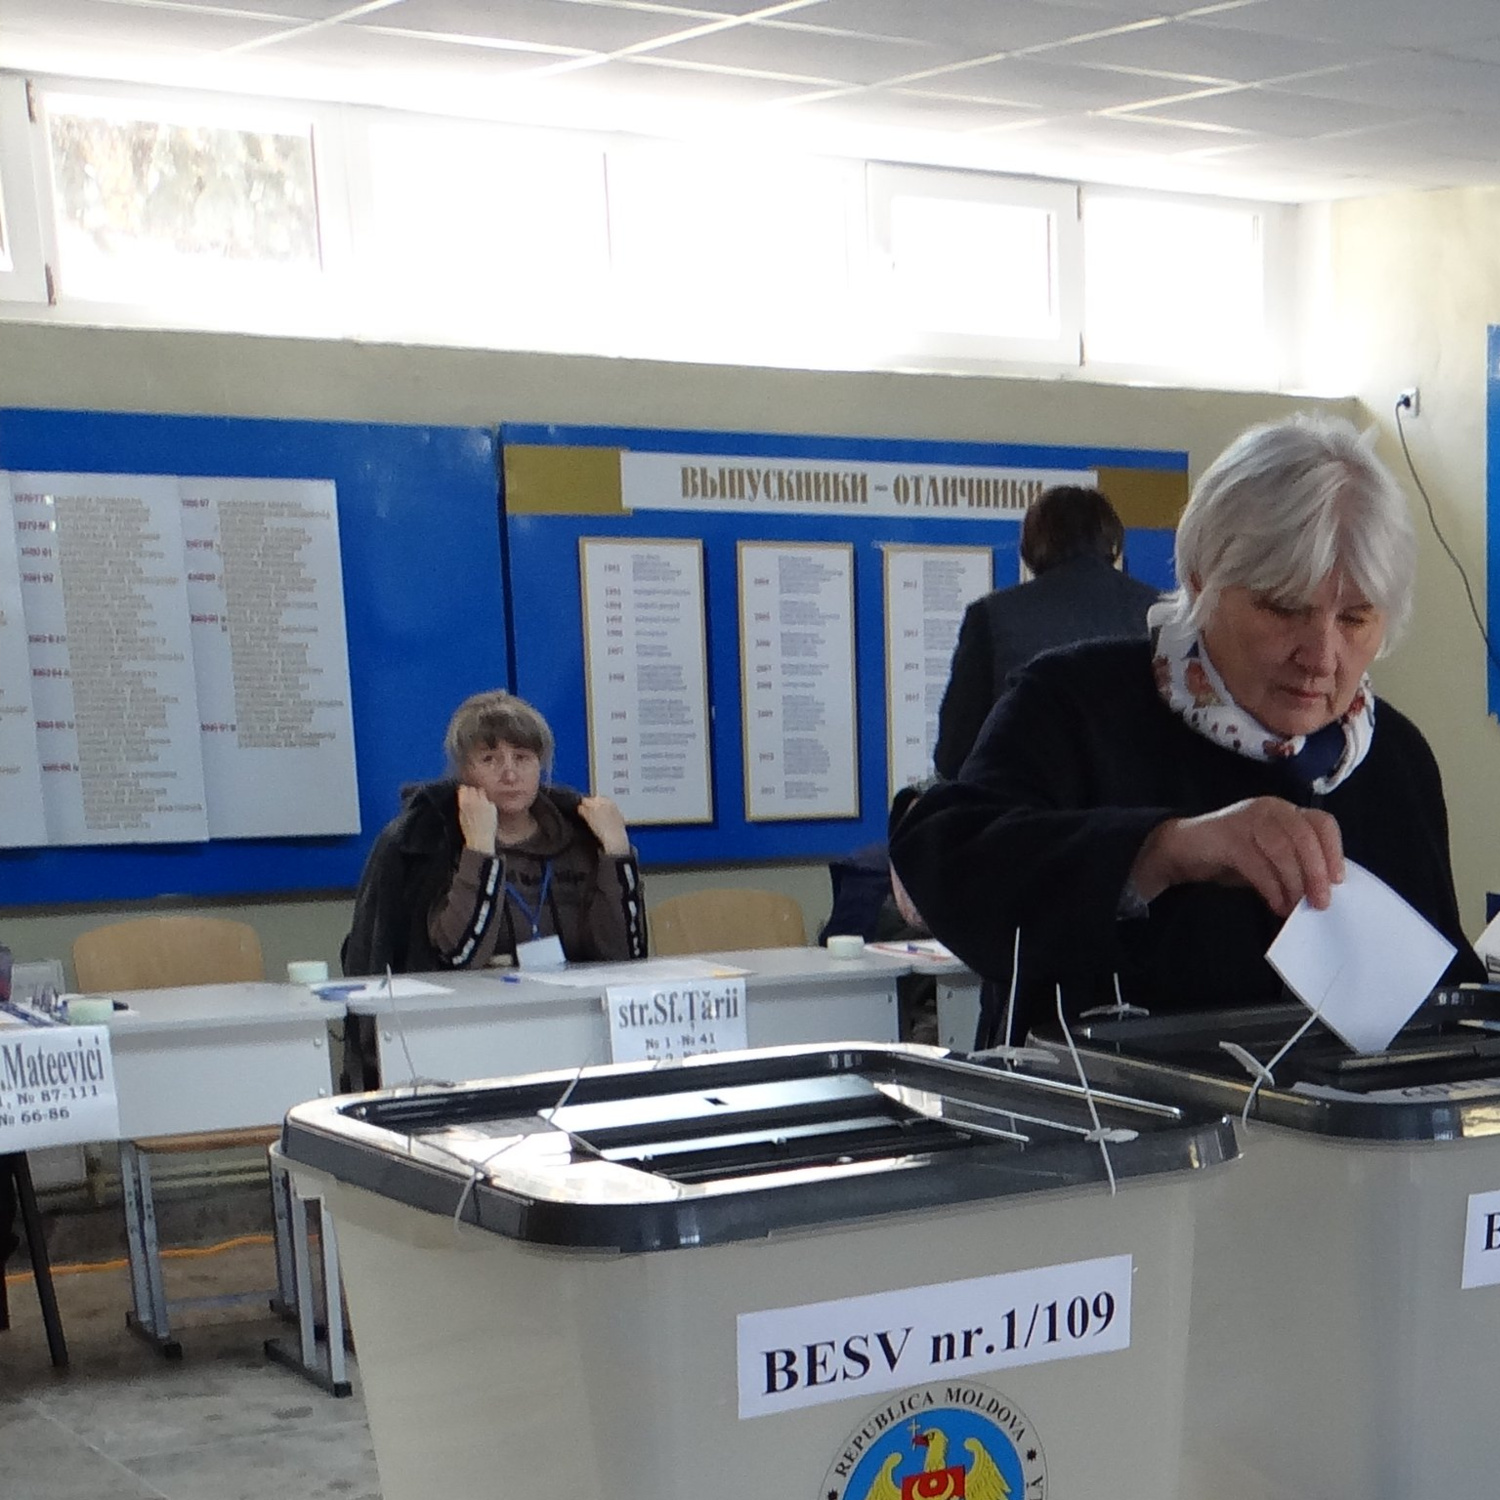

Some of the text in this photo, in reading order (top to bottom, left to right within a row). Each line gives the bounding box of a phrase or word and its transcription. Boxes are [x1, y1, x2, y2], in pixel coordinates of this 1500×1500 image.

[681, 467, 868, 504] ВЫПУСКНИКИ
[893, 474, 1043, 509] ОТЛИЧНИКИ
[41, 1084, 98, 1102] 87-111
[21, 1106, 70, 1124] 66-86
[762, 1291, 1116, 1395] BESV nr.1/109
[834, 1387, 1025, 1478] REPUBLICA MOLDOVA
